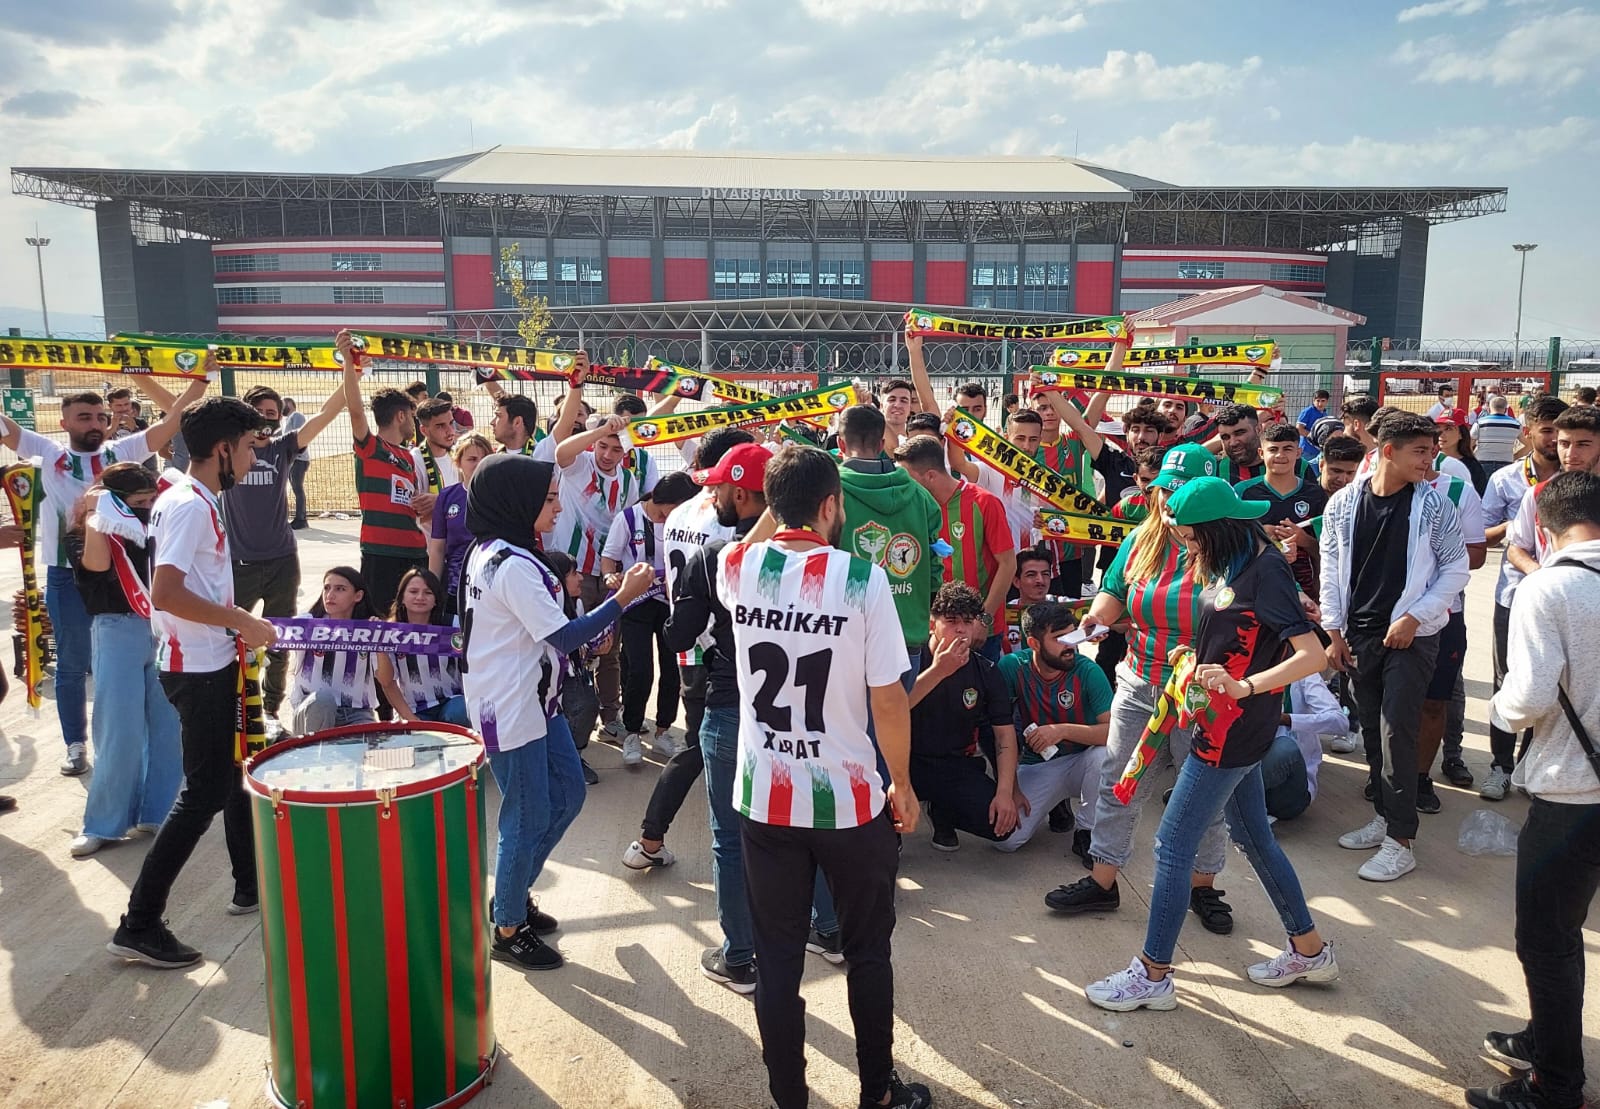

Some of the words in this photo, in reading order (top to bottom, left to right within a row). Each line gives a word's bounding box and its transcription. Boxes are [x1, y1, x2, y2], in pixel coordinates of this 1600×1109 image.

[821, 189, 908, 201] STADYUMU
[736, 602, 848, 636] BARİKAT
[311, 624, 437, 645] BARİKAT
[748, 641, 833, 734] 21
